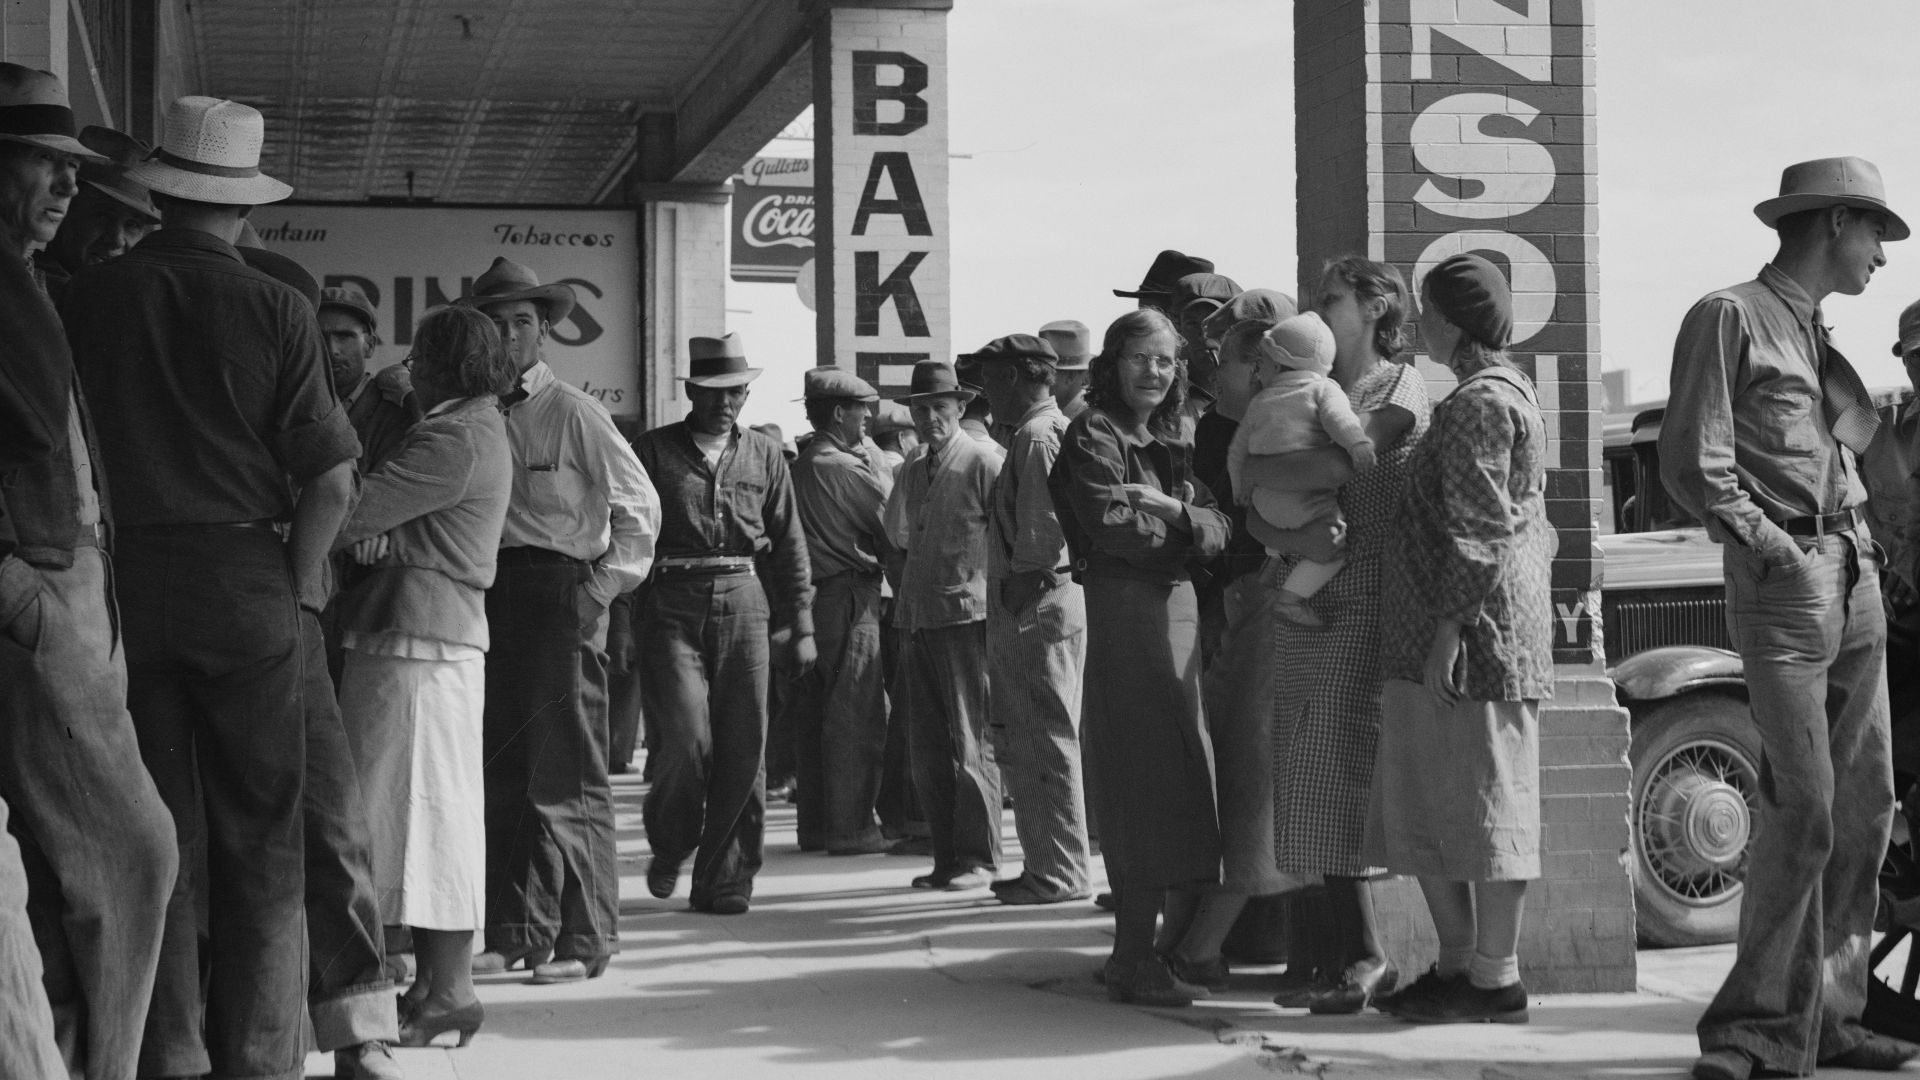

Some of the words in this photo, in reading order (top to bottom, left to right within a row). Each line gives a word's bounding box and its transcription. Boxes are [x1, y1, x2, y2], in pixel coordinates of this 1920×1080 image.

[784, 195, 815, 205] DRI
[259, 221, 326, 241] ntain
[494, 224, 615, 247] Tobaccos
[742, 194, 815, 248] Coca
